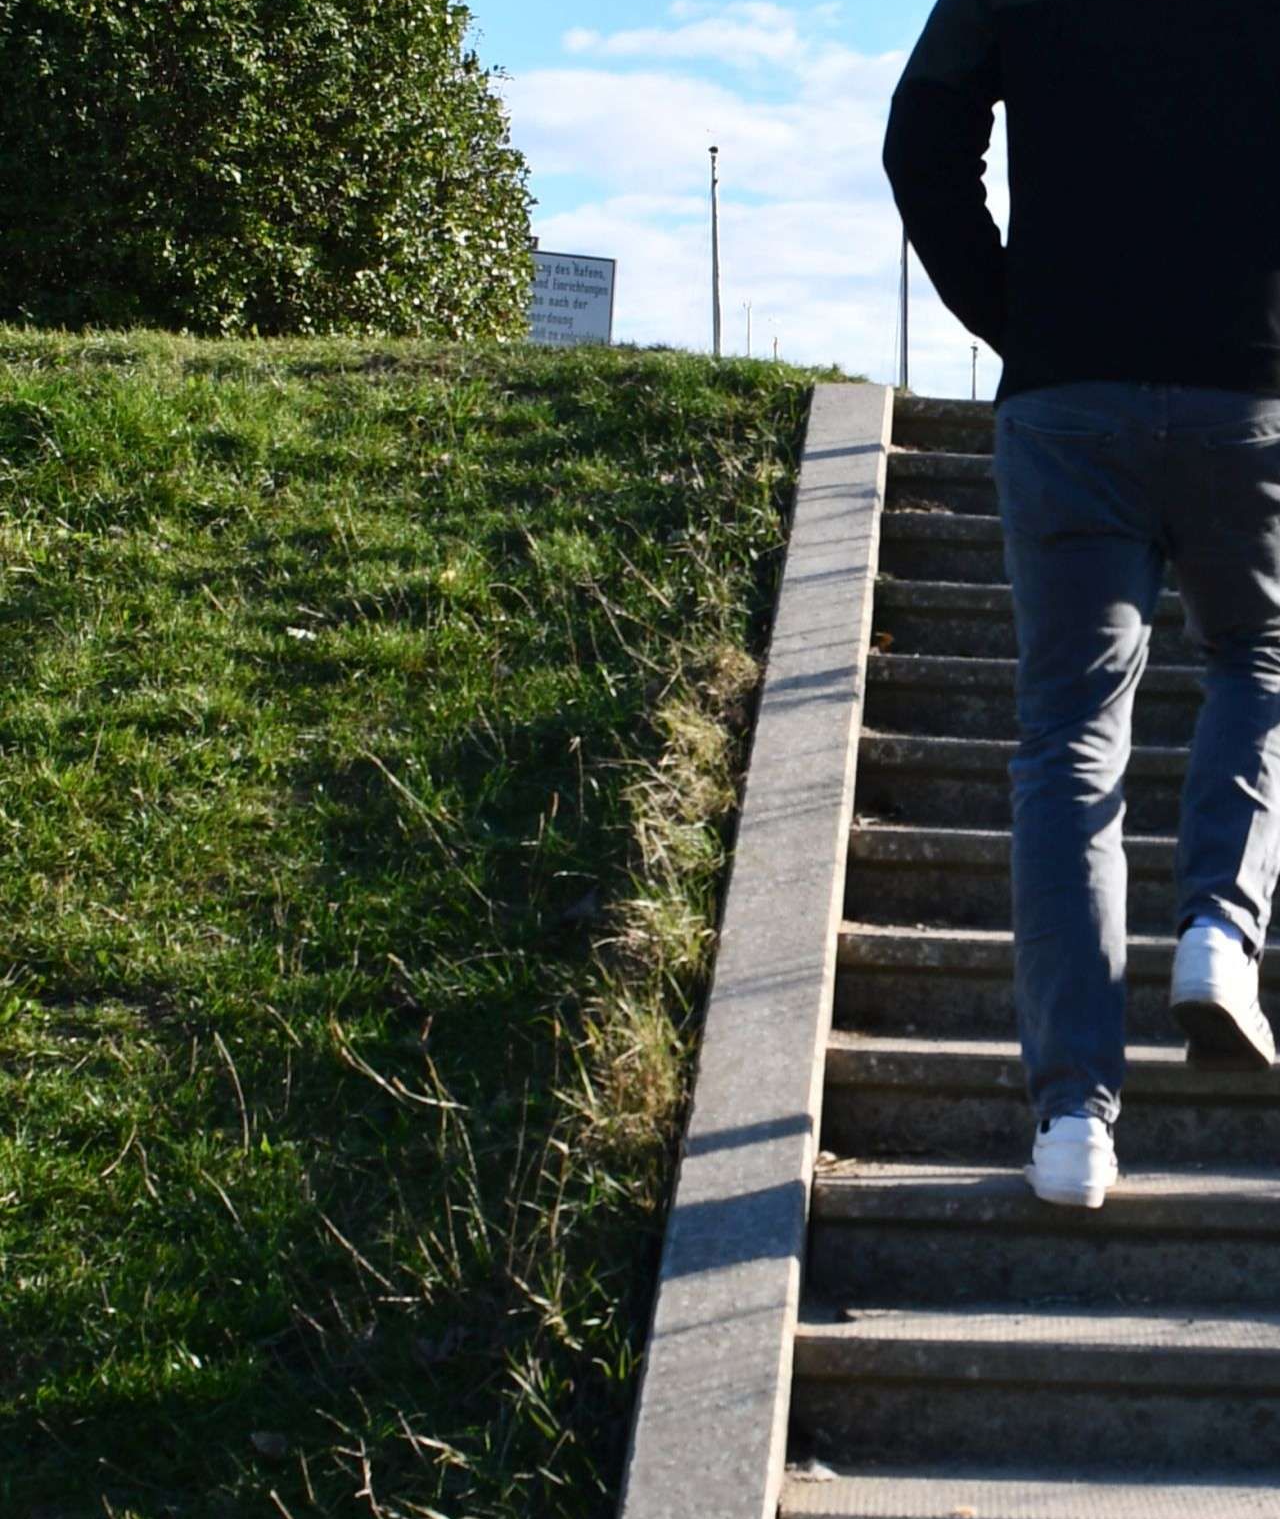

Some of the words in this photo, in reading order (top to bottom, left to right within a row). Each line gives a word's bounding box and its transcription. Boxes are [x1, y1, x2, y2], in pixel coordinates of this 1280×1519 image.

[555, 263, 570, 275] des
[549, 295, 569, 308] nach
[573, 298, 588, 310] der
